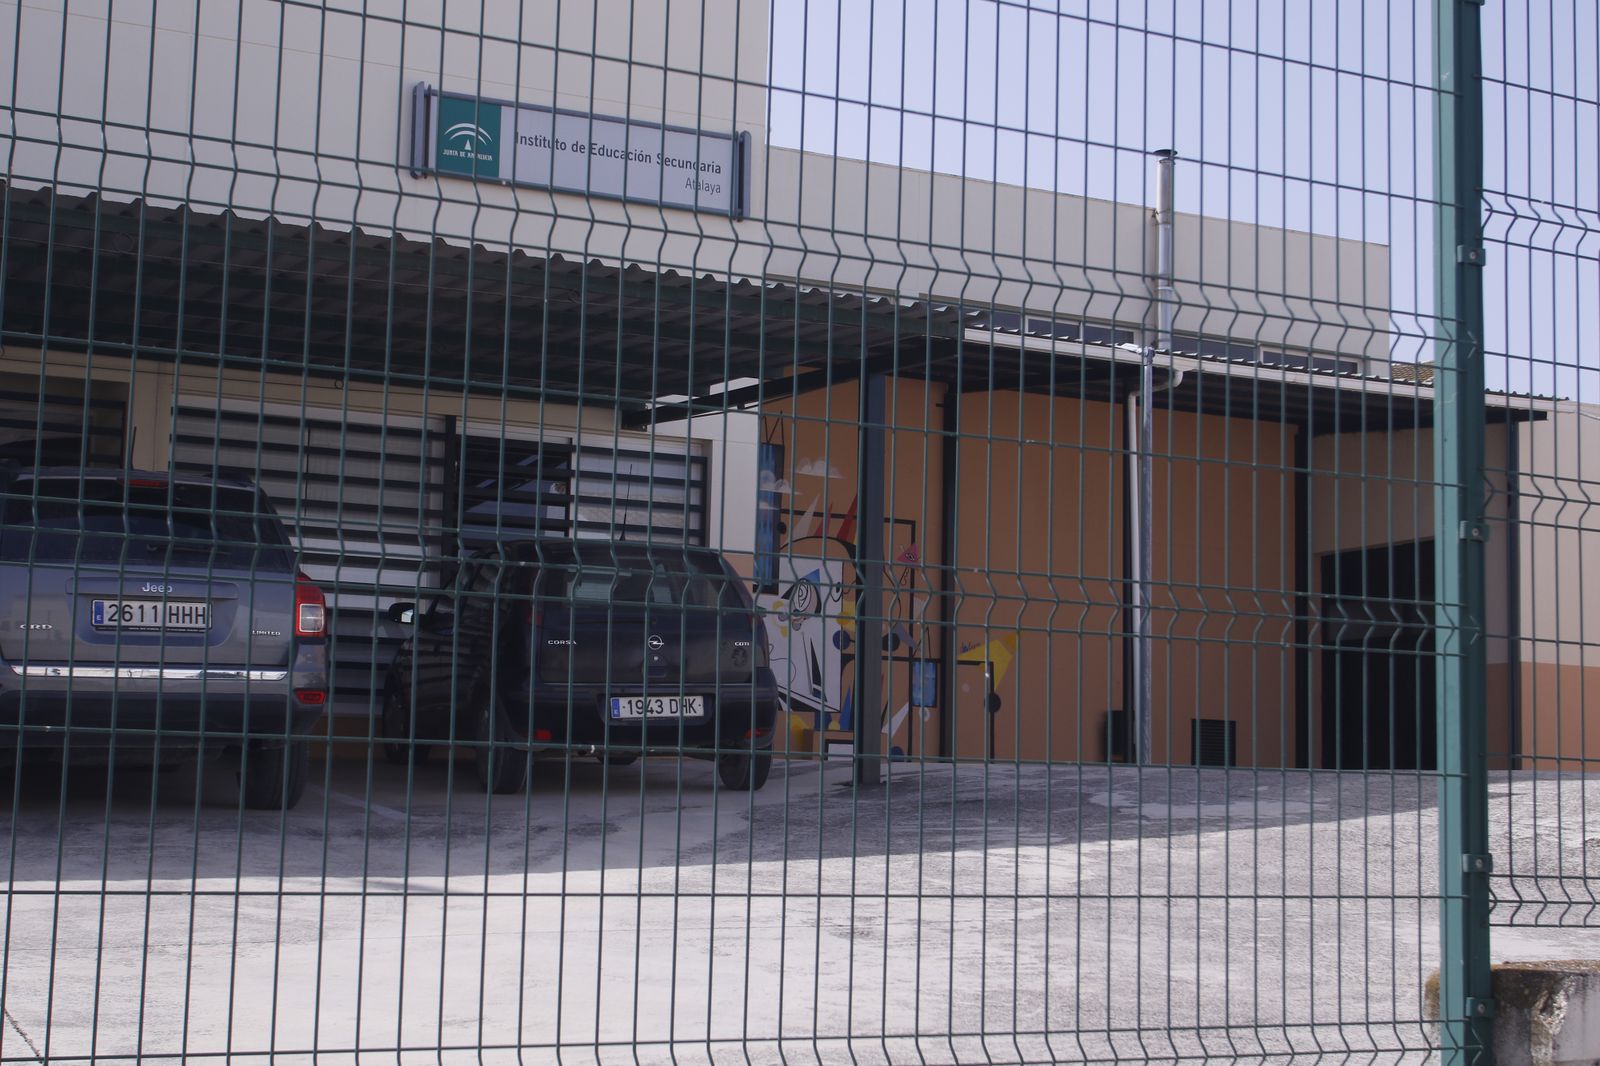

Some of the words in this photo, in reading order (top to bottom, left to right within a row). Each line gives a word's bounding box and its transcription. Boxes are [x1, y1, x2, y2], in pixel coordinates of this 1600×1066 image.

[467, 152, 493, 161] ANALUCIA
[515, 131, 567, 151] Instituto
[571, 141, 586, 154] de
[589, 142, 652, 164] Educación
[685, 177, 721, 196] Atalaya
[142, 582, 173, 593] Jeep
[107, 603, 158, 623] 2611
[168, 605, 206, 624] HHH
[627, 699, 664, 715] 1943
[669, 698, 697, 714] DHK
